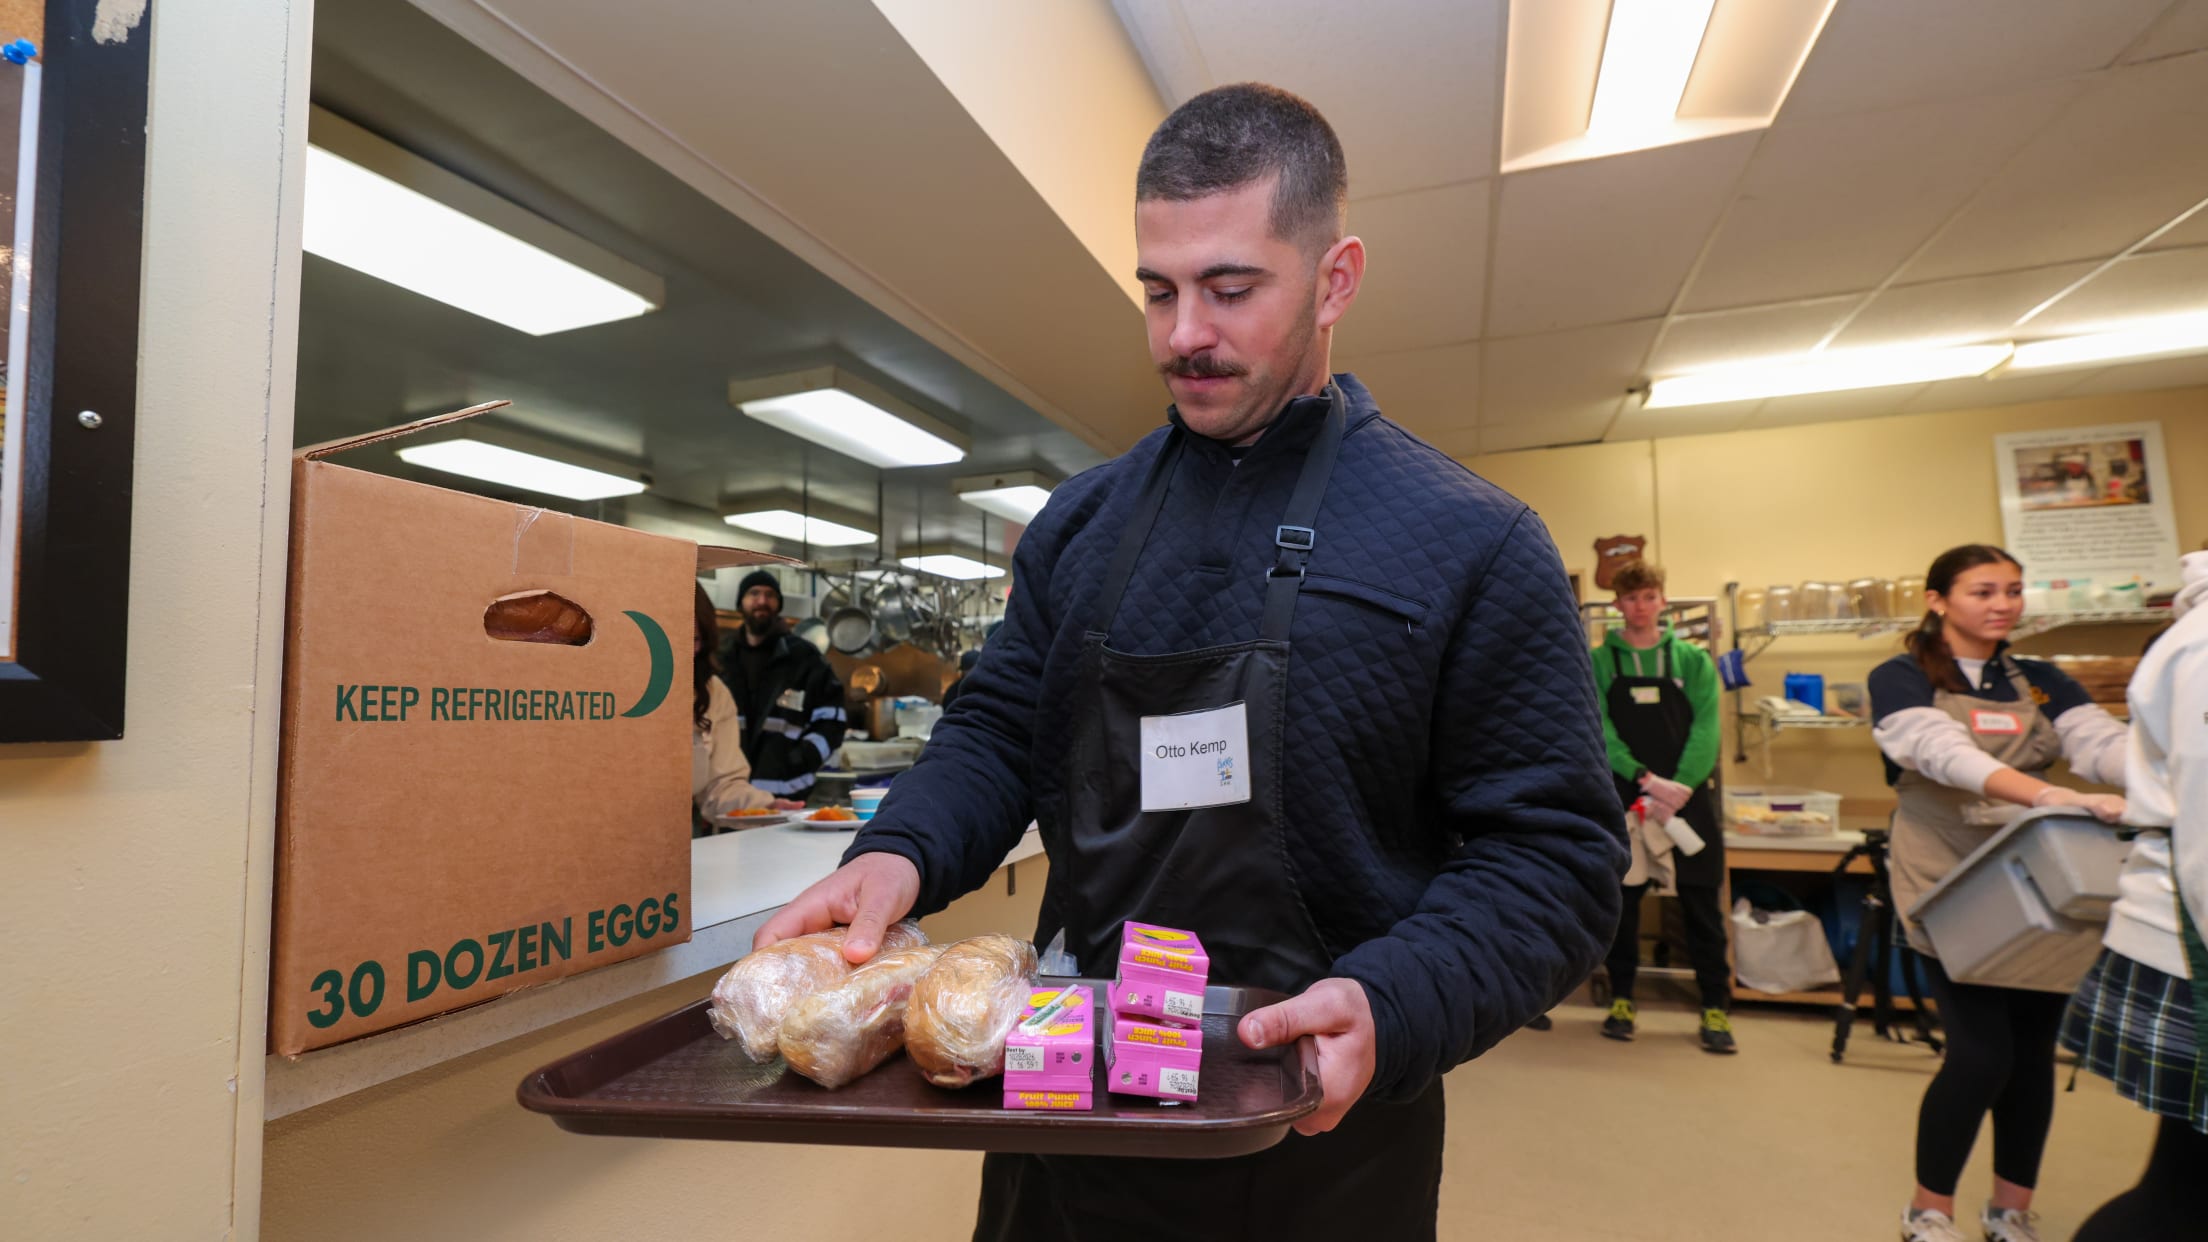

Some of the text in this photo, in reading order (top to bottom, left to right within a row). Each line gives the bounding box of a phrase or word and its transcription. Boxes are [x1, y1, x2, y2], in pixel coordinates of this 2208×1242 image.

[335, 684, 615, 722] KEEP REFRIGERATED
[1155, 739, 1227, 759] Otto Kemp
[306, 892, 680, 1029] 30 DOZEN EGGS
[1134, 955, 1166, 966] Punch
[1133, 1026, 1156, 1036] JUICE
[1127, 1033, 1187, 1047] Fruit Punch
[1019, 1092, 1080, 1101] Fruit Punch
